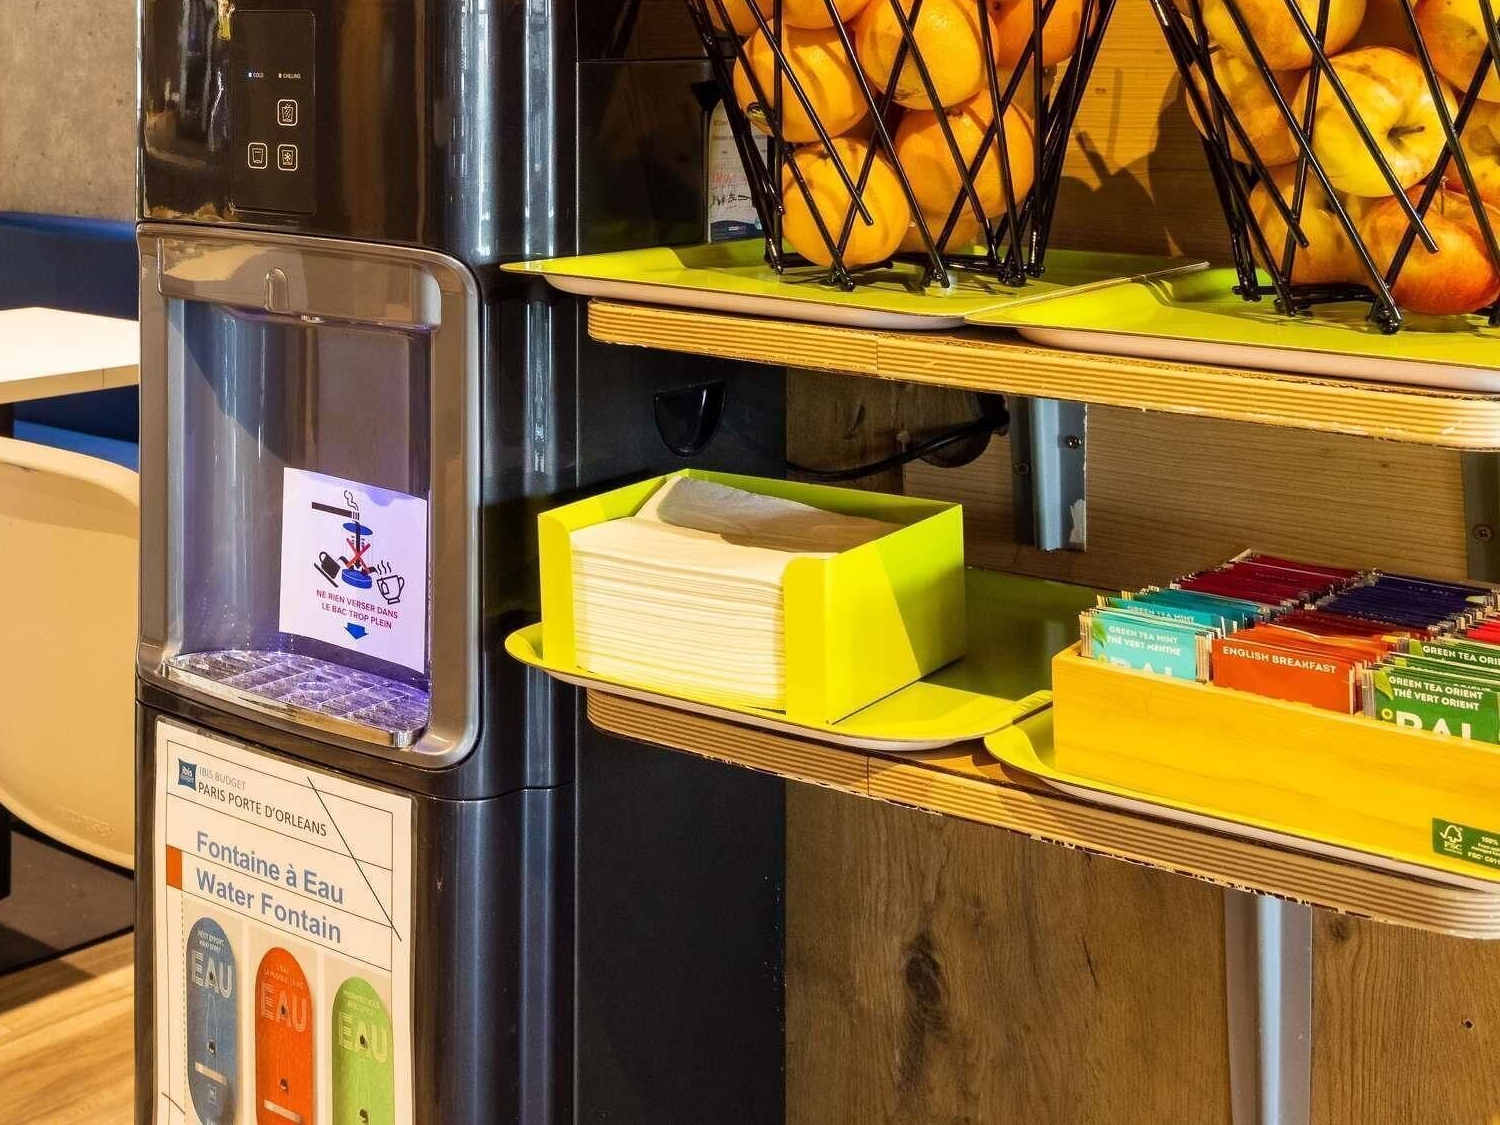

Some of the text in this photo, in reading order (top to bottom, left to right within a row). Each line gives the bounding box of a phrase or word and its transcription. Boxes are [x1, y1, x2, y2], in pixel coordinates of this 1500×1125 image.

[316, 589, 398, 619] NE RIEN VERSER DANS
[322, 602, 392, 629] LE BAC TROP PLEIN
[1108, 625, 1178, 644] GREEN TEA MINT
[1123, 638, 1145, 649] VERT
[1147, 642, 1181, 656] MENTHE
[1222, 646, 1337, 674] ENGLISH BREAKFAST
[1422, 645, 1456, 658] GREEN
[1458, 651, 1477, 662] TEA
[1388, 676, 1421, 689] GREEN
[1423, 682, 1443, 693] TEA
[1444, 686, 1484, 700] ORIENT
[1393, 687, 1480, 711] THÉ VERT ORIENT
[199, 765, 246, 790] IBIS BUDGET
[198, 781, 327, 837] PARIS PORTE D'ORLEANS
[1443, 840, 1462, 851] FSC
[196, 830, 344, 905] Fontaine à Eau
[196, 867, 341, 944] Water Fontain
[191, 949, 233, 999] EAU
[260, 982, 307, 1033] EAU
[338, 1011, 387, 1064] EAU
